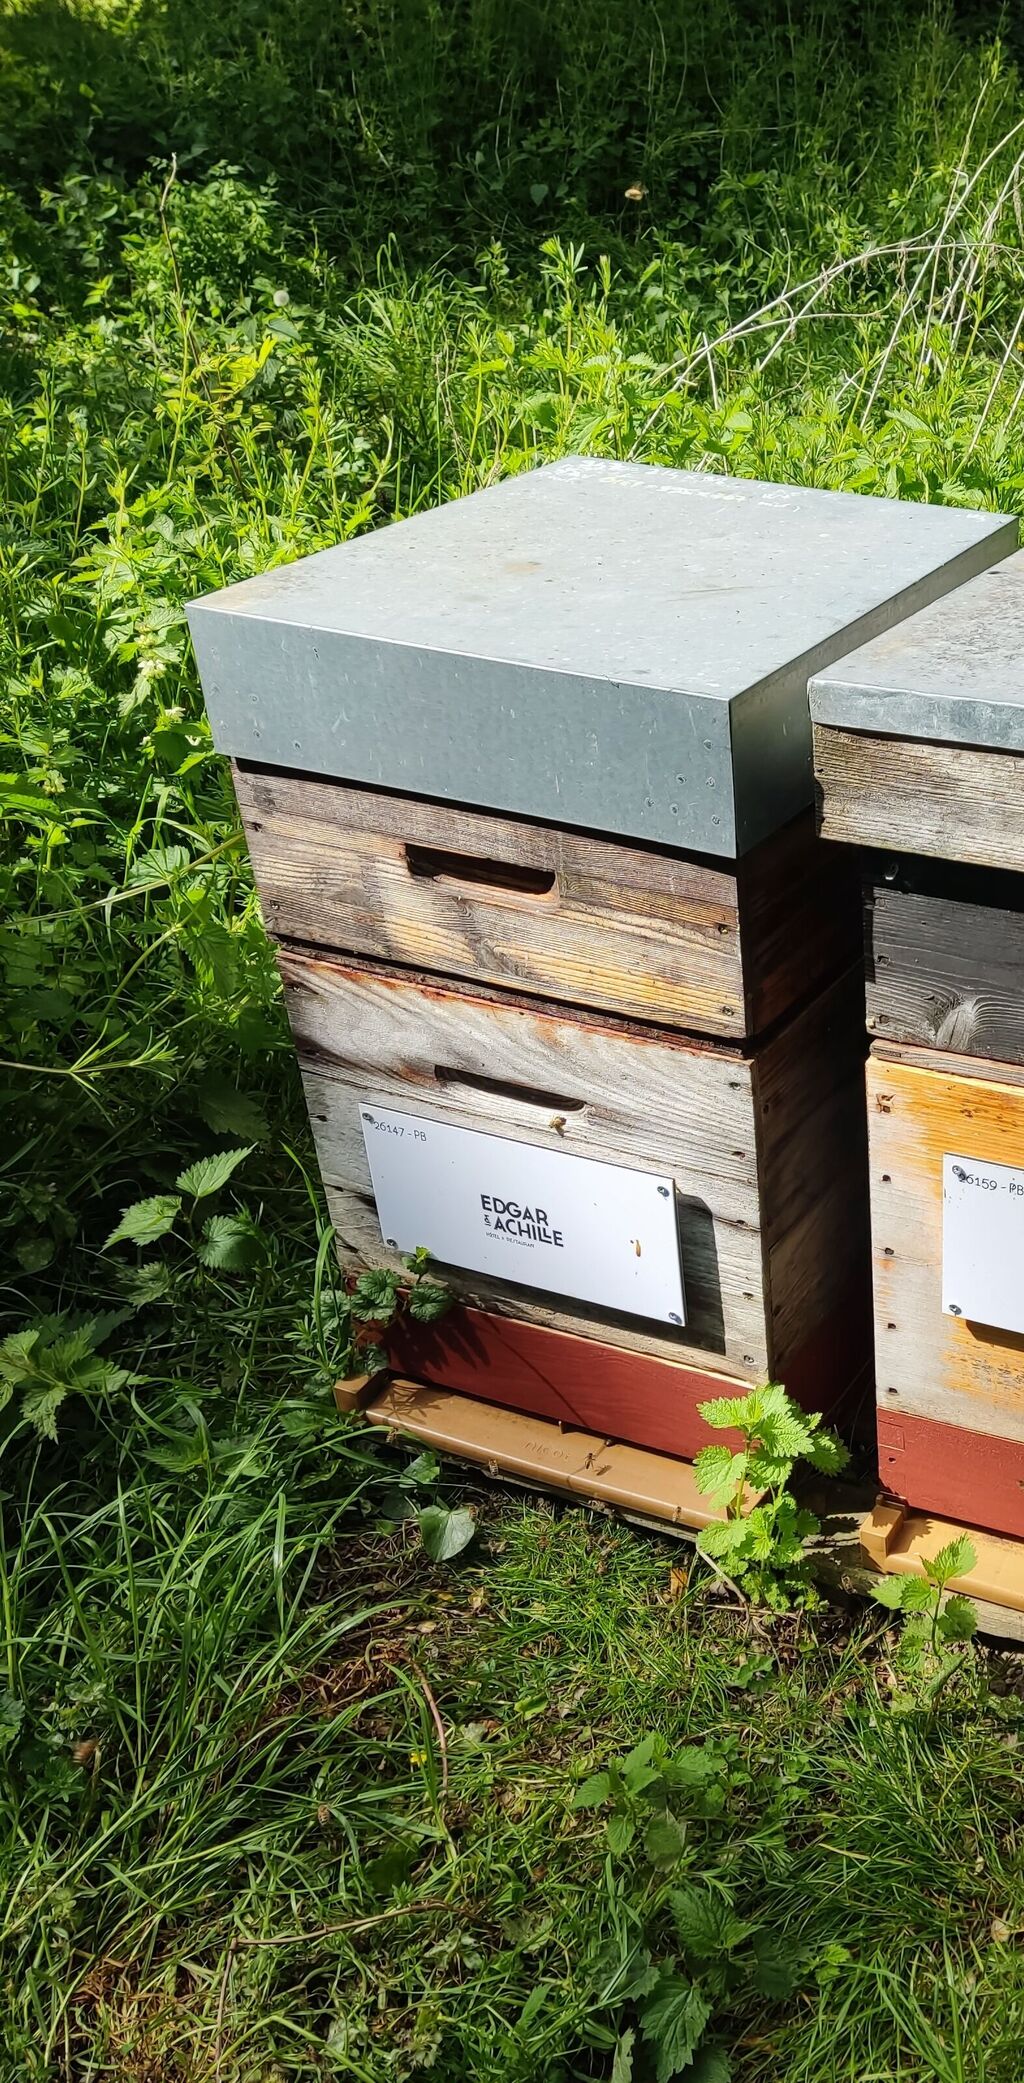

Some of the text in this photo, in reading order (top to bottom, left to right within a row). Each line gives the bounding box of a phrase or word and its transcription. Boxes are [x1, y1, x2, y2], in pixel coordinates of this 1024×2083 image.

[373, 1120, 405, 1137] 26147
[413, 1129, 427, 1142] PB
[1009, 1182, 1024, 1196] PB
[480, 1193, 549, 1227] EDGAR
[494, 1215, 564, 1248] ACHILLE
